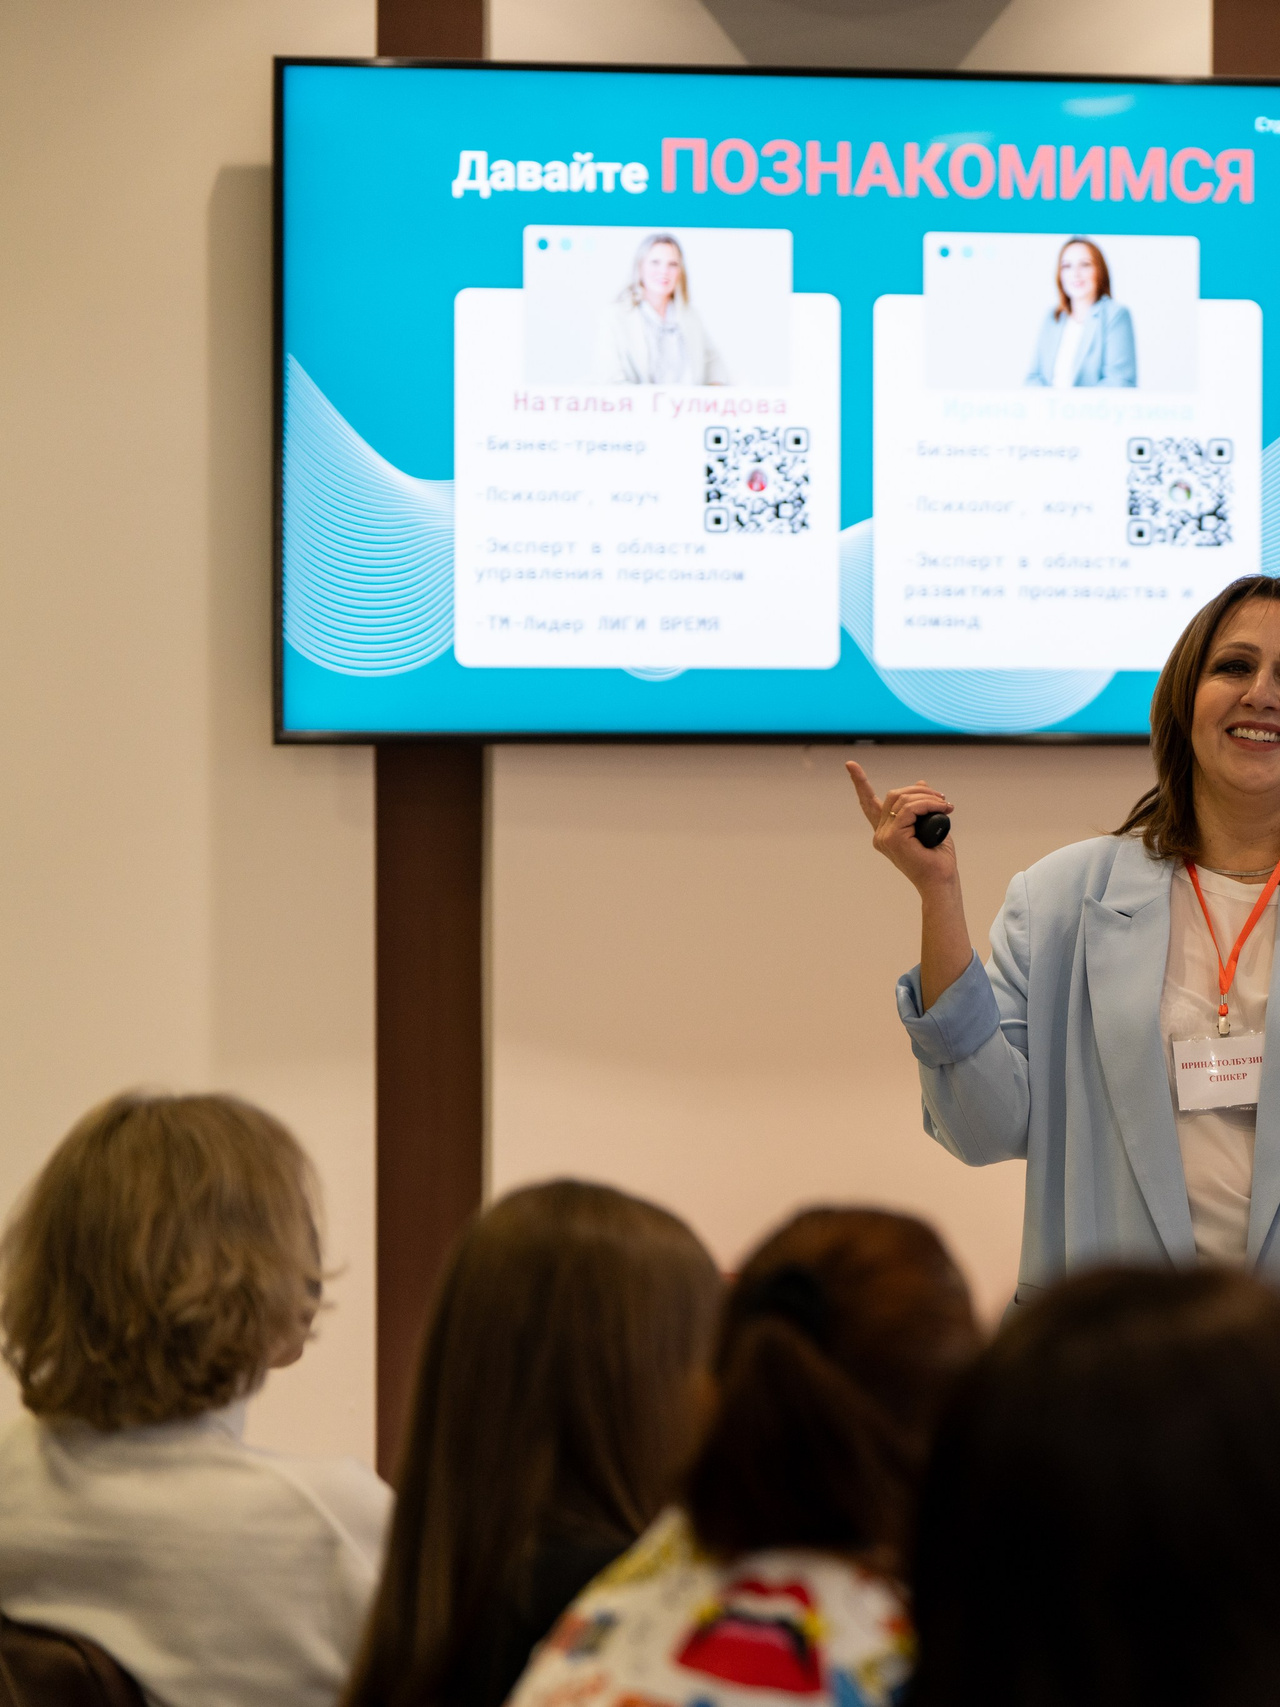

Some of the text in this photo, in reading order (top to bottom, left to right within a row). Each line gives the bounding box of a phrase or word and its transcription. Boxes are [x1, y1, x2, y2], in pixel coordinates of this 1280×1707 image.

[452, 137, 1255, 204] Давайте ПОЗНАКОМИМСЯ
[513, 390, 787, 418] Наталья Гулидова
[610, 490, 659, 507] коуч
[591, 542, 602, 554] в
[616, 537, 706, 555] области
[1018, 557, 1029, 569] в
[1042, 551, 1131, 570] области
[475, 567, 746, 583] управления персоналом
[904, 583, 1193, 602] развития производства и
[597, 616, 647, 632] ЛИГИ
[660, 616, 720, 632] ВРЕМЯ
[904, 614, 982, 631] команд
[1181, 1060, 1214, 1070] ИРИНА
[1209, 1072, 1248, 1083] СПИКЕР
